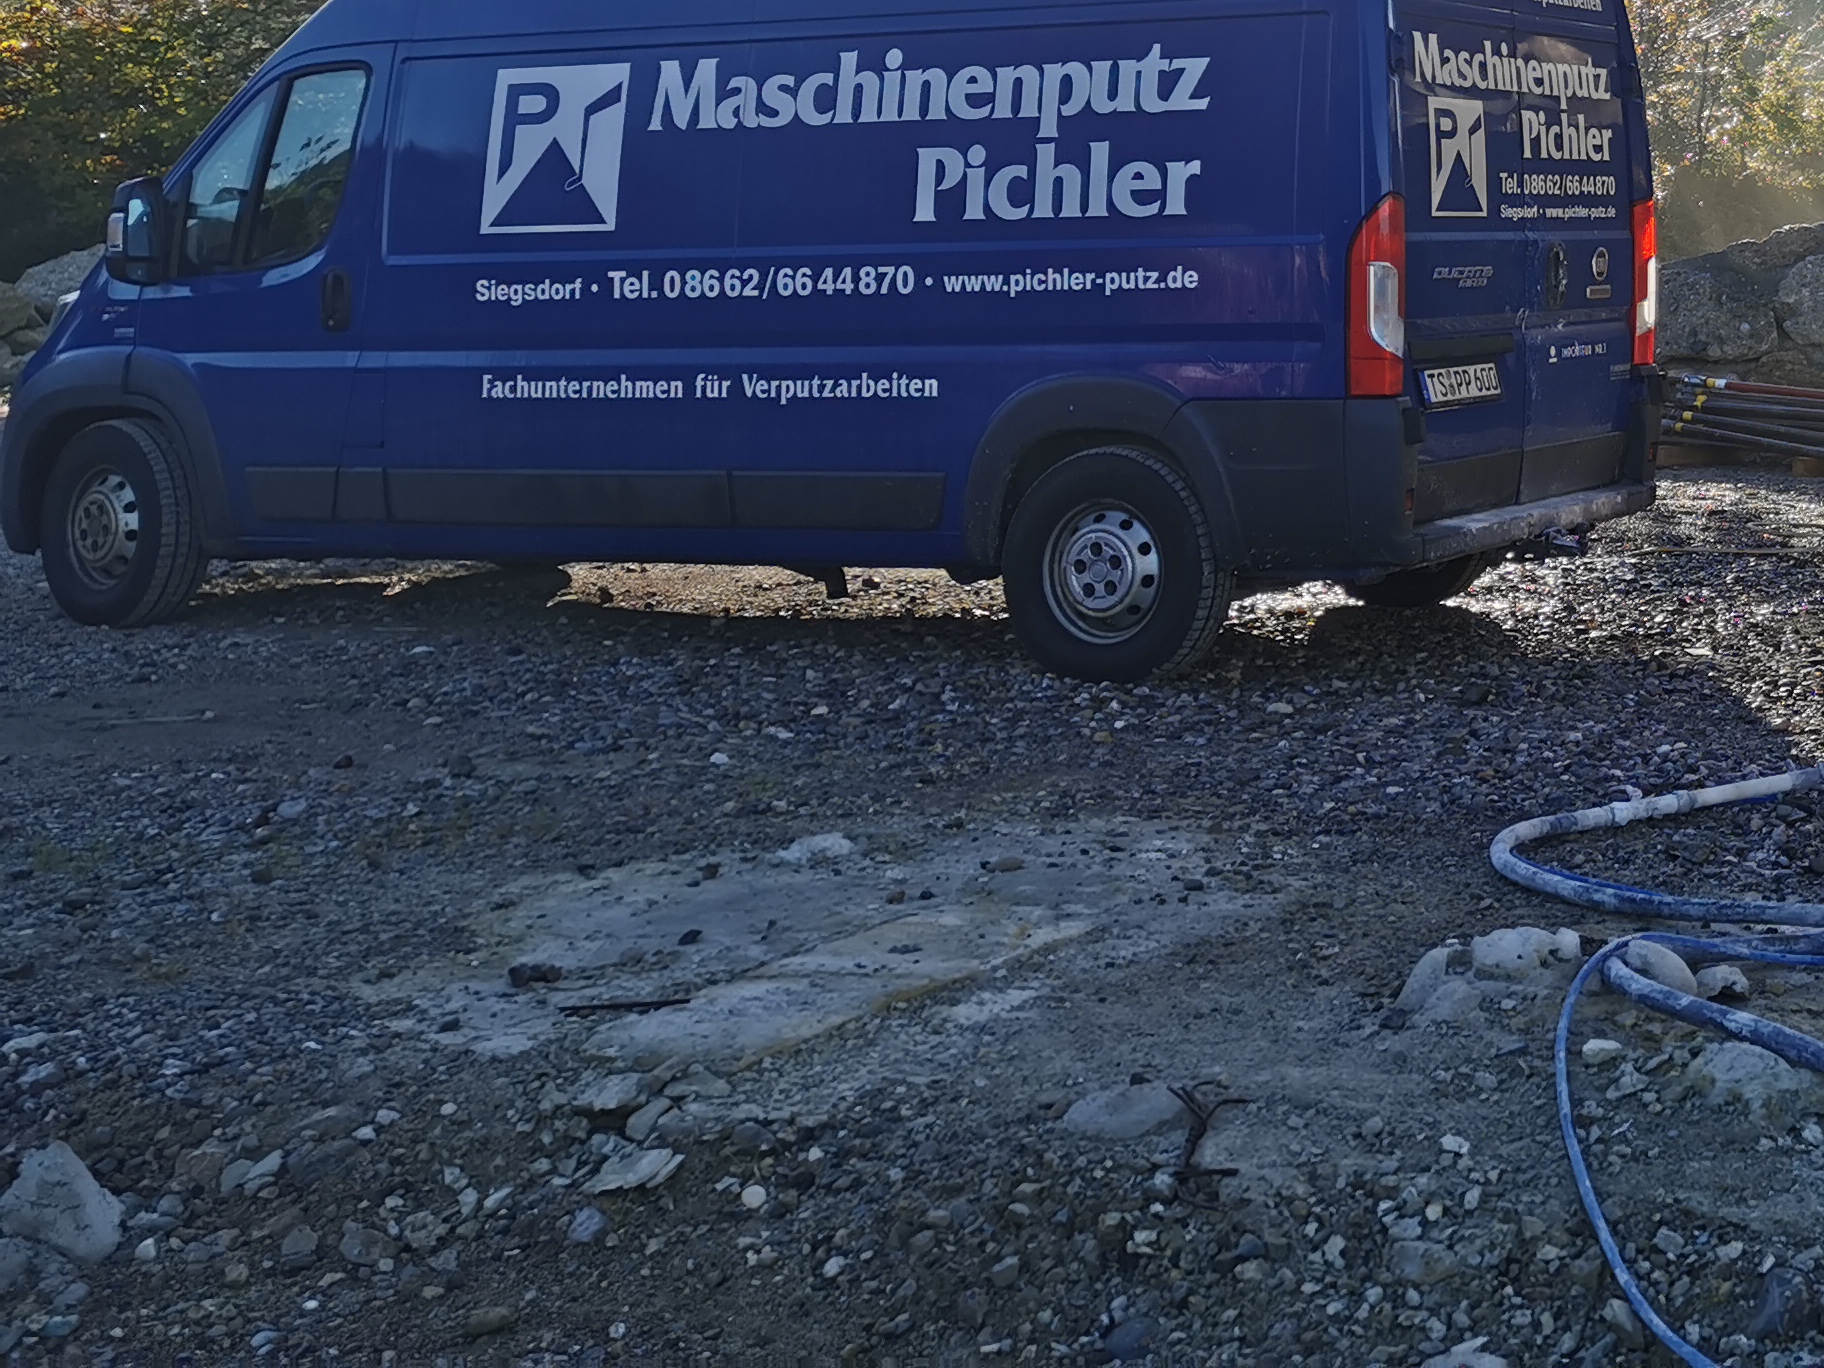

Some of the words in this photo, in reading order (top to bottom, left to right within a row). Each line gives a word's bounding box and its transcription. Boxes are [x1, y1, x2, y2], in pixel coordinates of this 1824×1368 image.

[647, 42, 1212, 138] Maschinenputz
[1411, 30, 1611, 110] Maschinenputz
[1520, 109, 1613, 162] Pichler
[912, 140, 1202, 222] Pichler
[1499, 172, 1521, 195] Tel.
[1500, 204, 1538, 221] Siegsdorf
[1545, 205, 1617, 221] www.pichler-putz.de
[474, 277, 583, 307] Siegsdorf
[607, 269, 658, 300] Tel.
[942, 265, 1199, 298] www.pichler-putz.de
[481, 374, 683, 399] Fachunternehmen
[694, 373, 732, 399] für
[741, 372, 939, 406] Verputzarbeiten
[1474, 366, 1499, 393] 600
